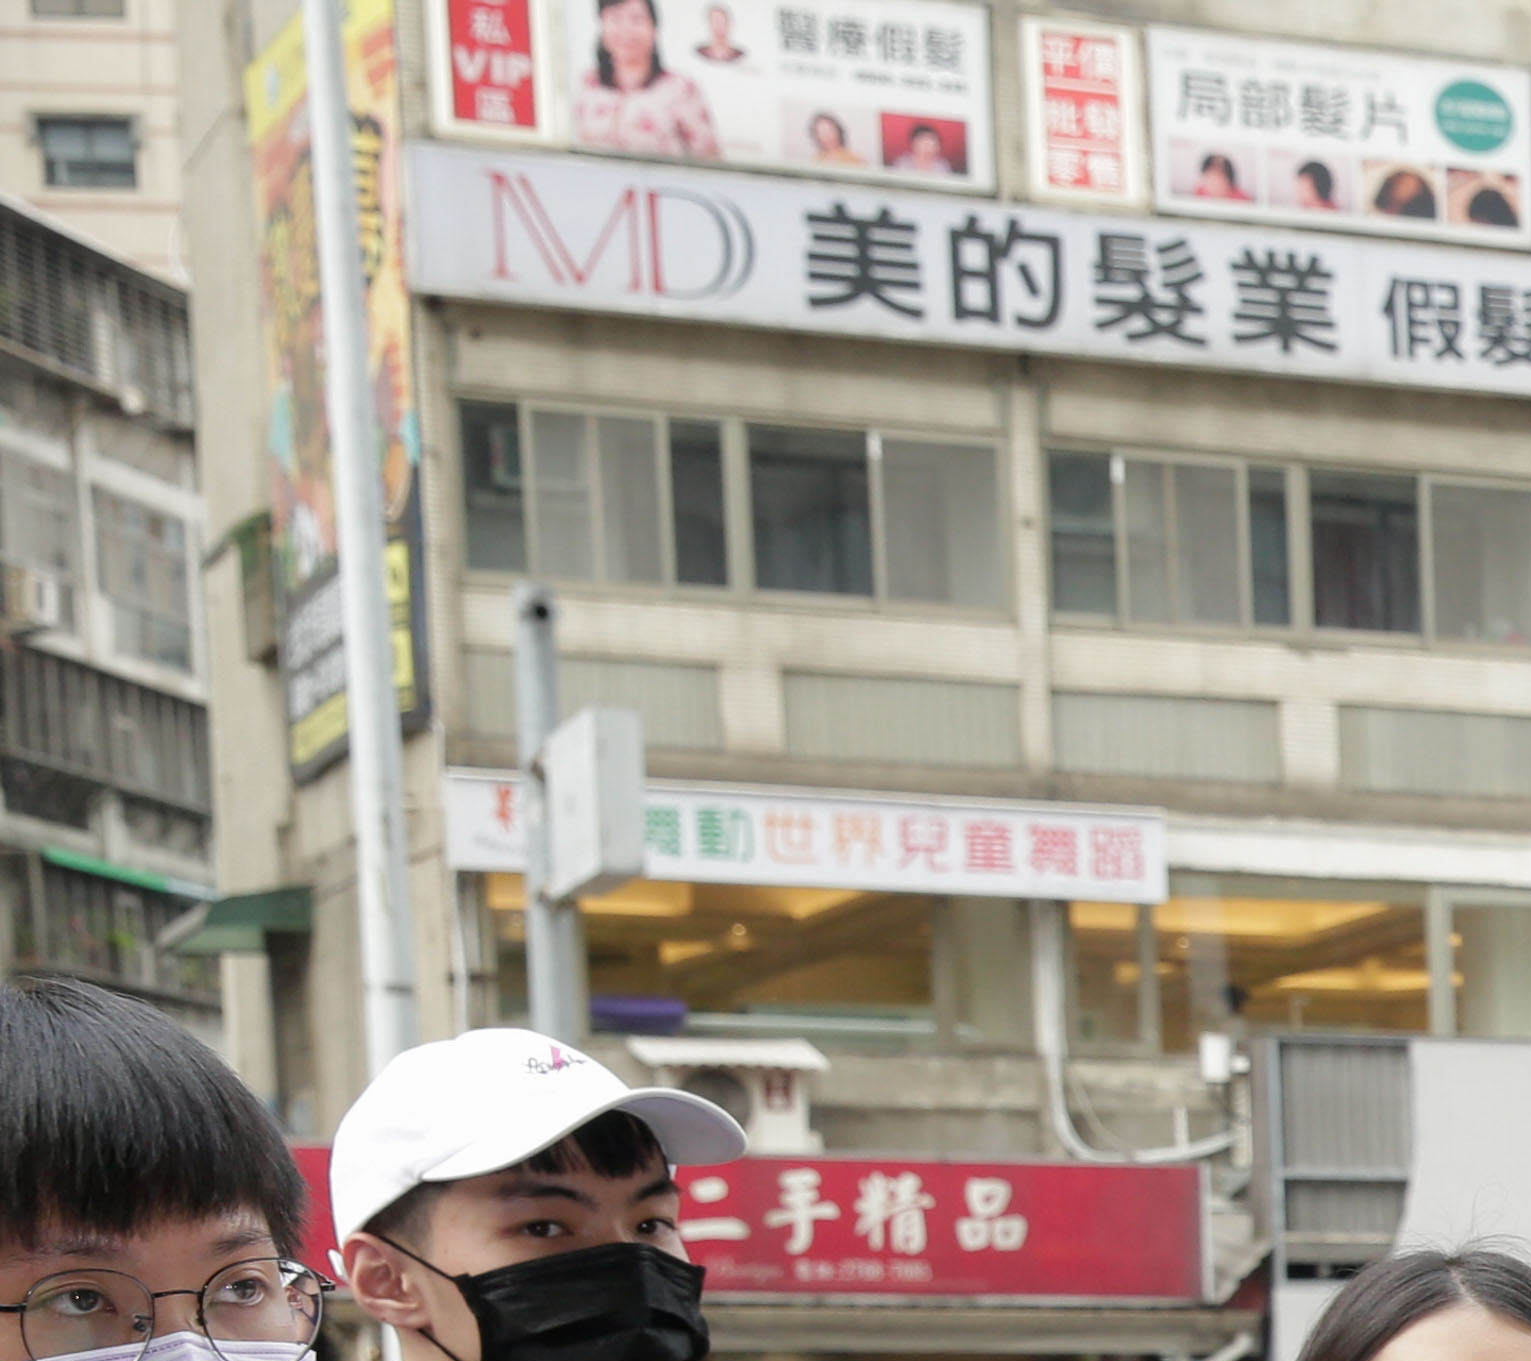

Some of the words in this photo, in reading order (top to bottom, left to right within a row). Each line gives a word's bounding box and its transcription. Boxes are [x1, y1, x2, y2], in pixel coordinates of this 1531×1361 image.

[1178, 70, 1409, 144] 局部髮片
[806, 204, 1340, 354] 美的髮業
[679, 1168, 1029, 1256] 二手精品
